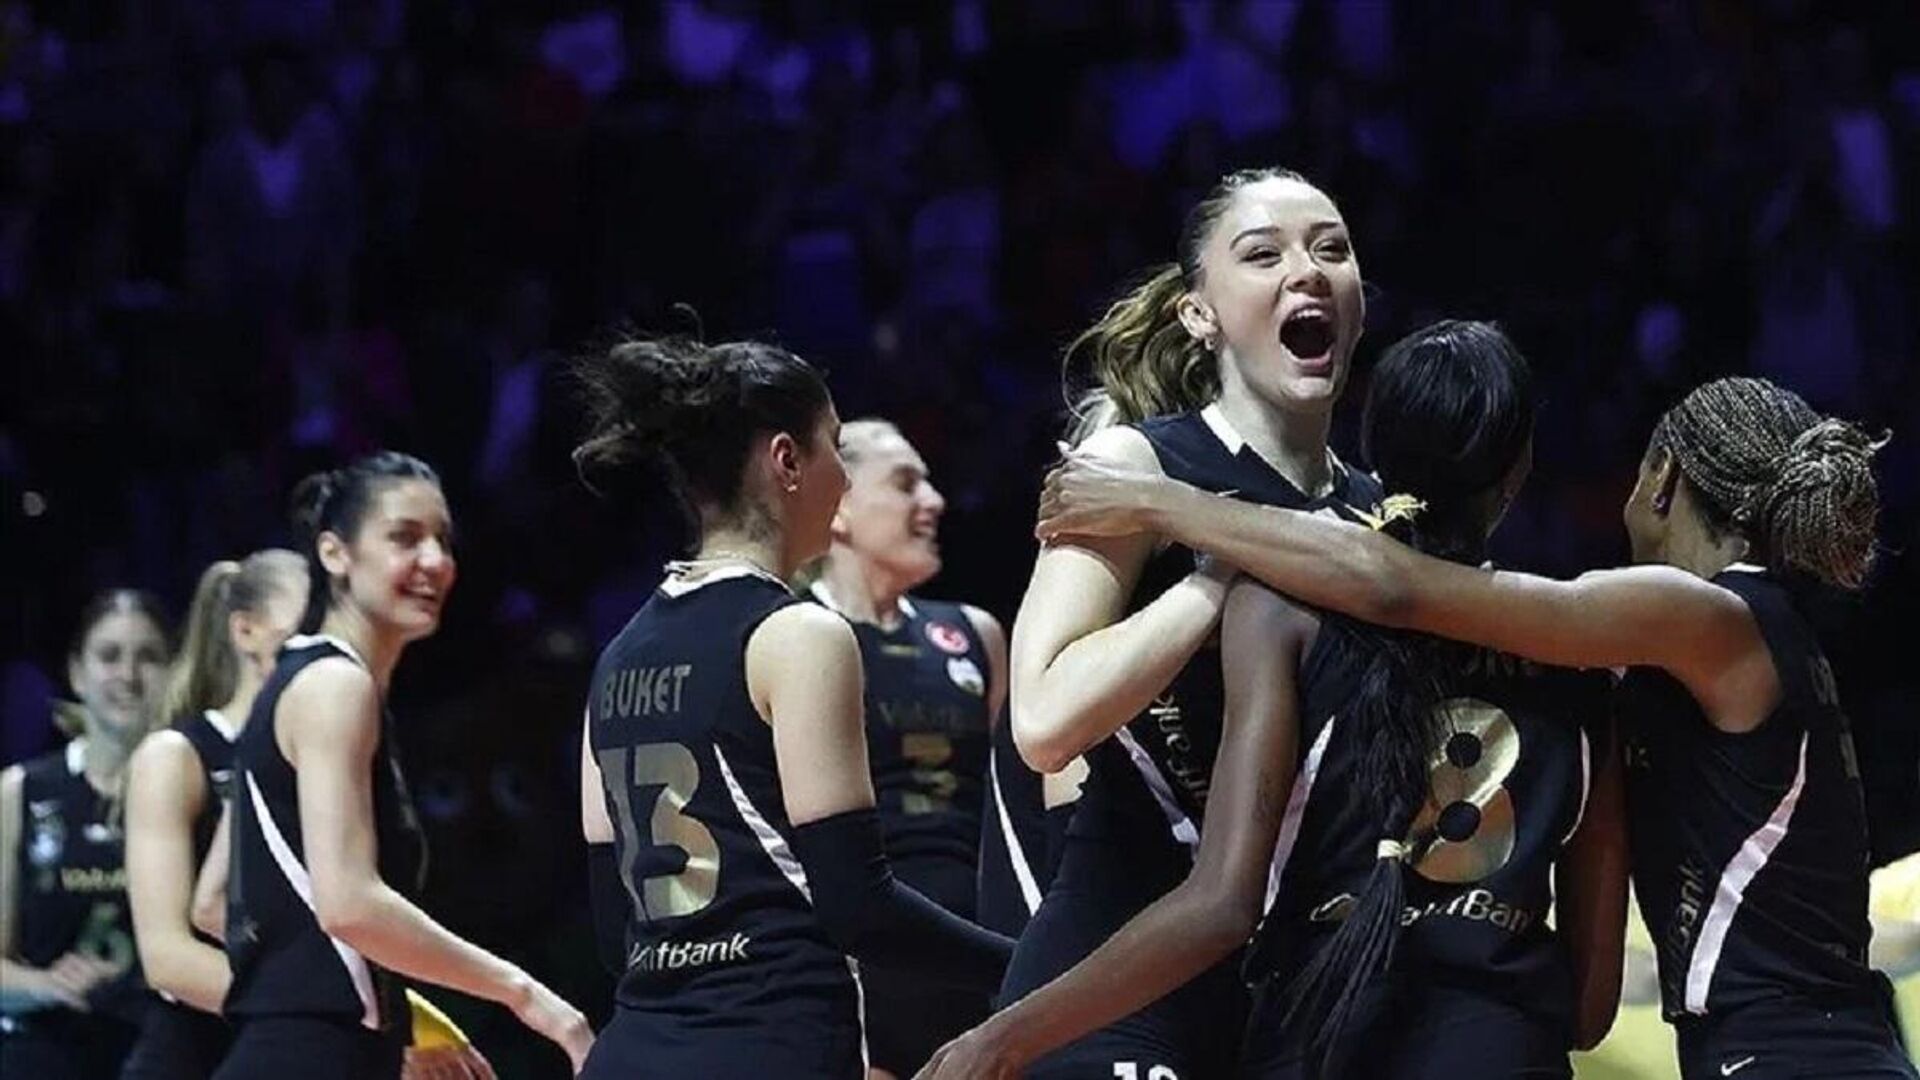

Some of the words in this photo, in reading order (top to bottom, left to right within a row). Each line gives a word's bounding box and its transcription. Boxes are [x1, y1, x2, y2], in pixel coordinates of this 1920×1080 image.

[600, 664, 692, 721] BUKET
[599, 742, 720, 922] 13
[1409, 697, 1520, 884] 8
